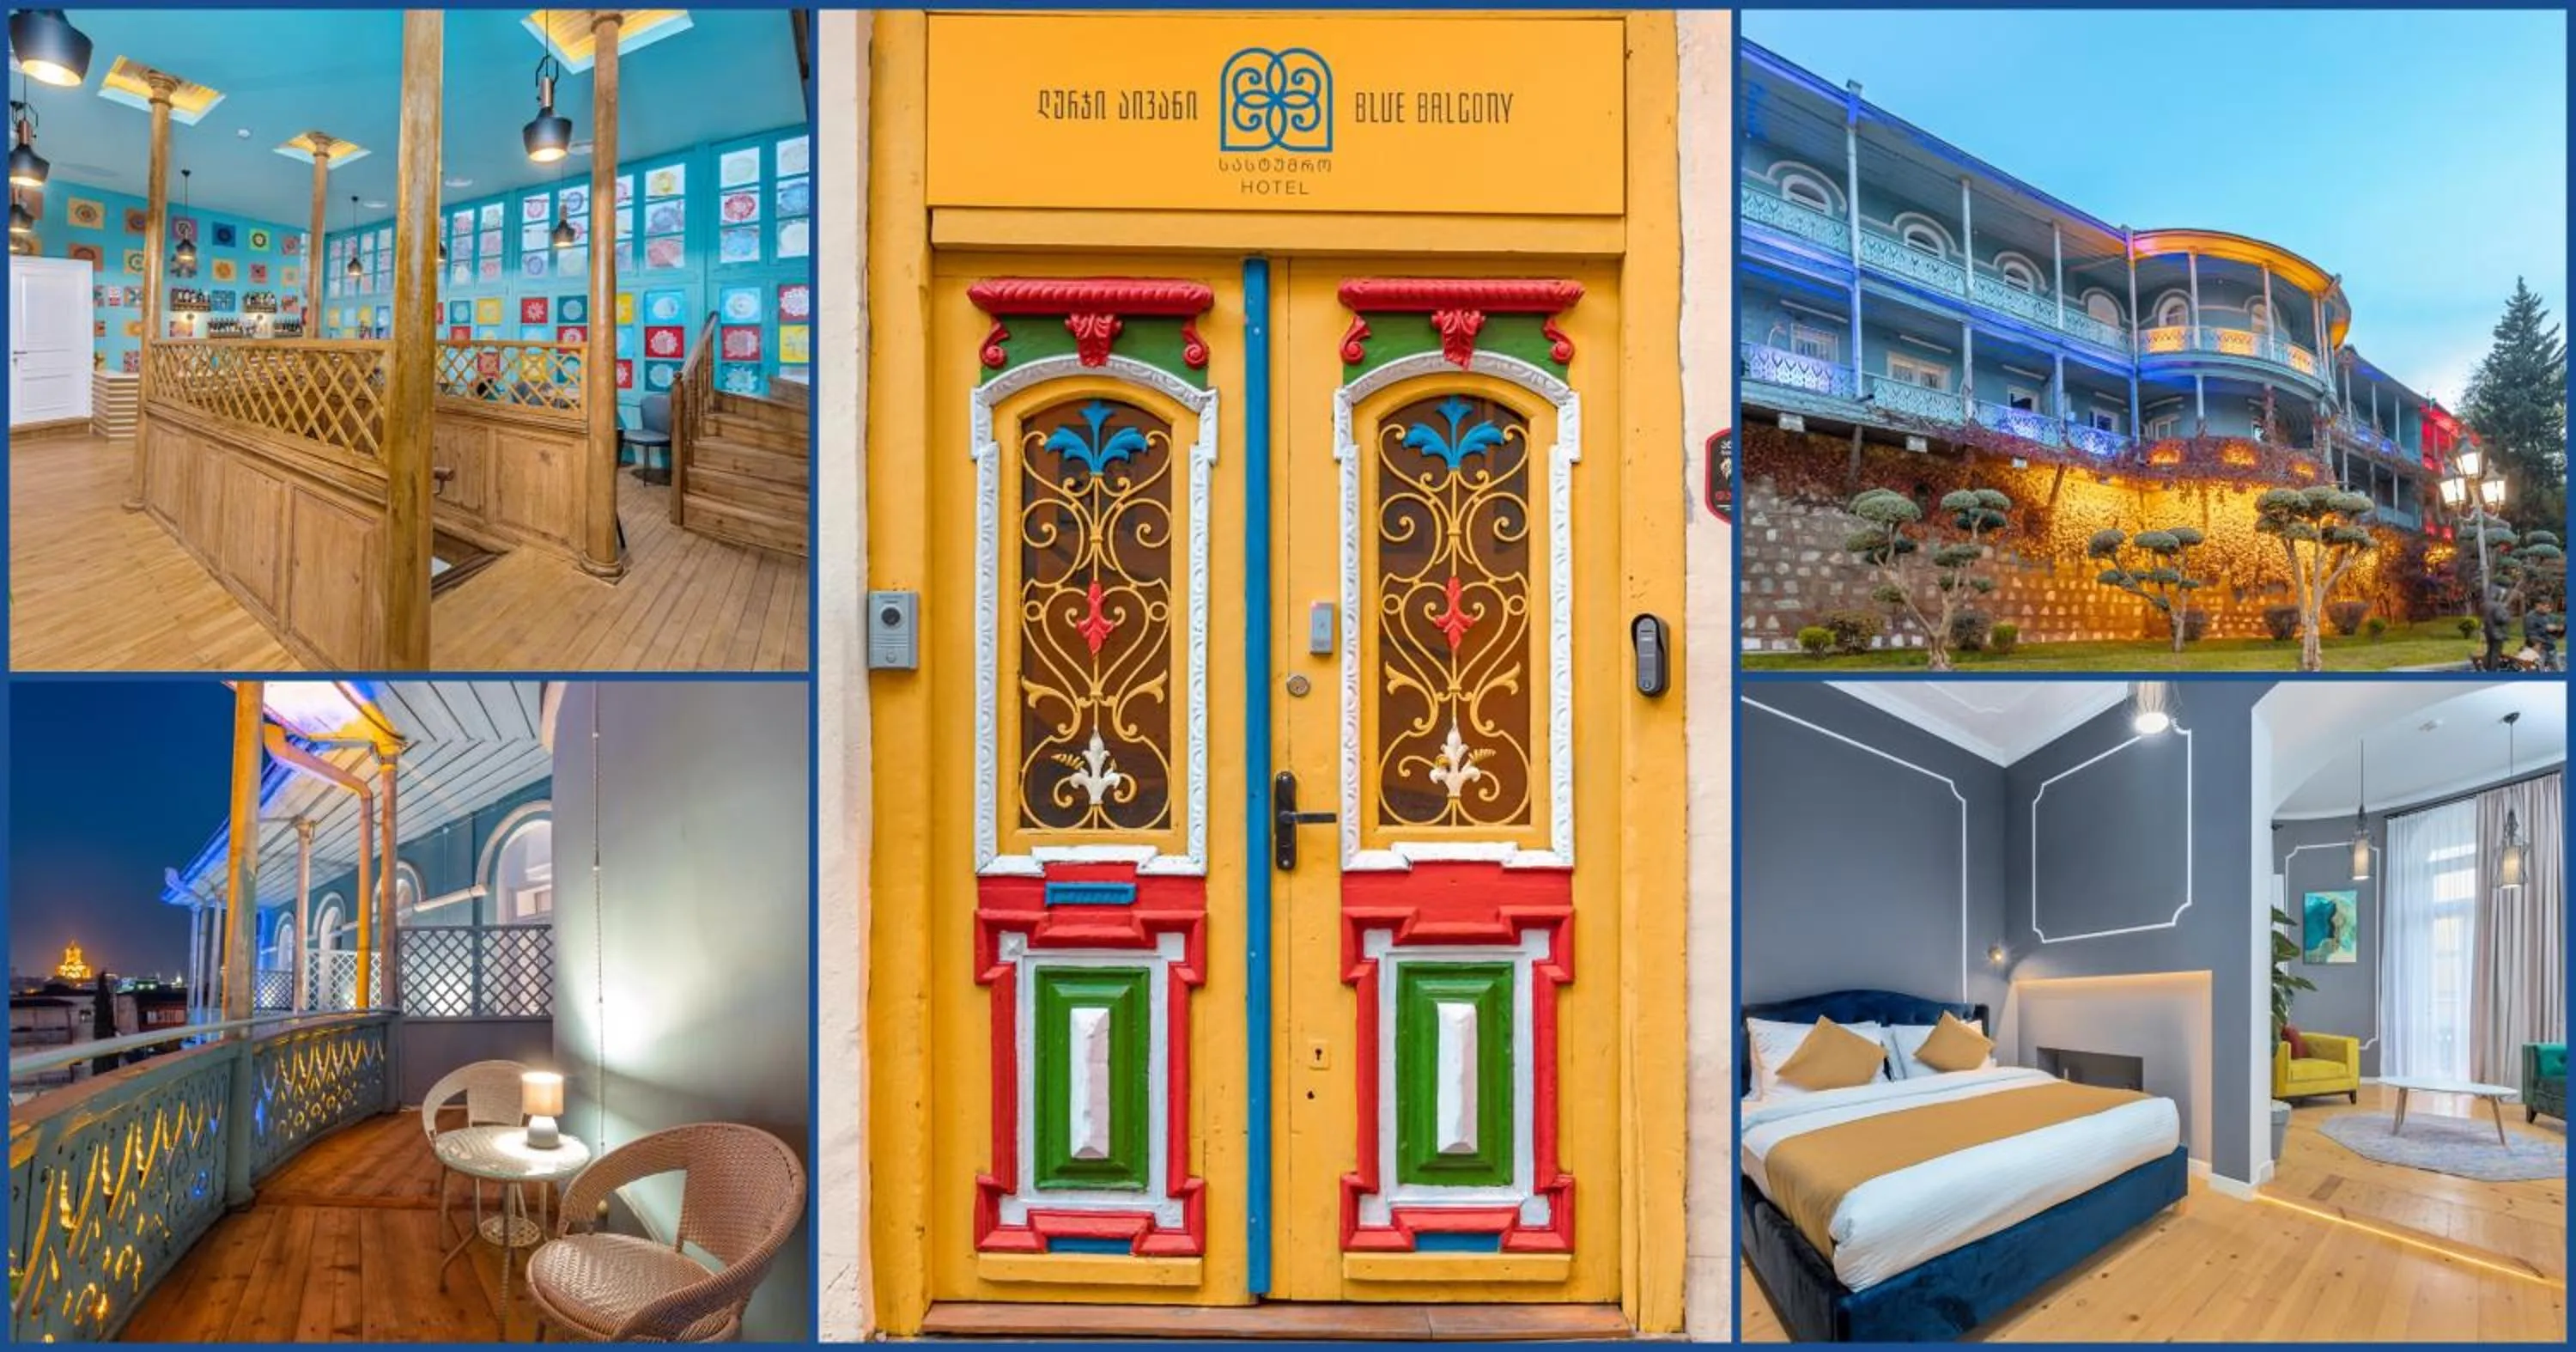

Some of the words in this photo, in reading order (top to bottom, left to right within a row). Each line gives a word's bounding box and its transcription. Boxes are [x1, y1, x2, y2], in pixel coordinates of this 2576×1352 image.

[1119, 89, 1198, 120] აივანი
[1355, 92, 1406, 123] BLUE
[1417, 92, 1514, 124] BALCONY
[1218, 157, 1332, 173] სასტუმრო
[1240, 178, 1310, 195] HOTEL
